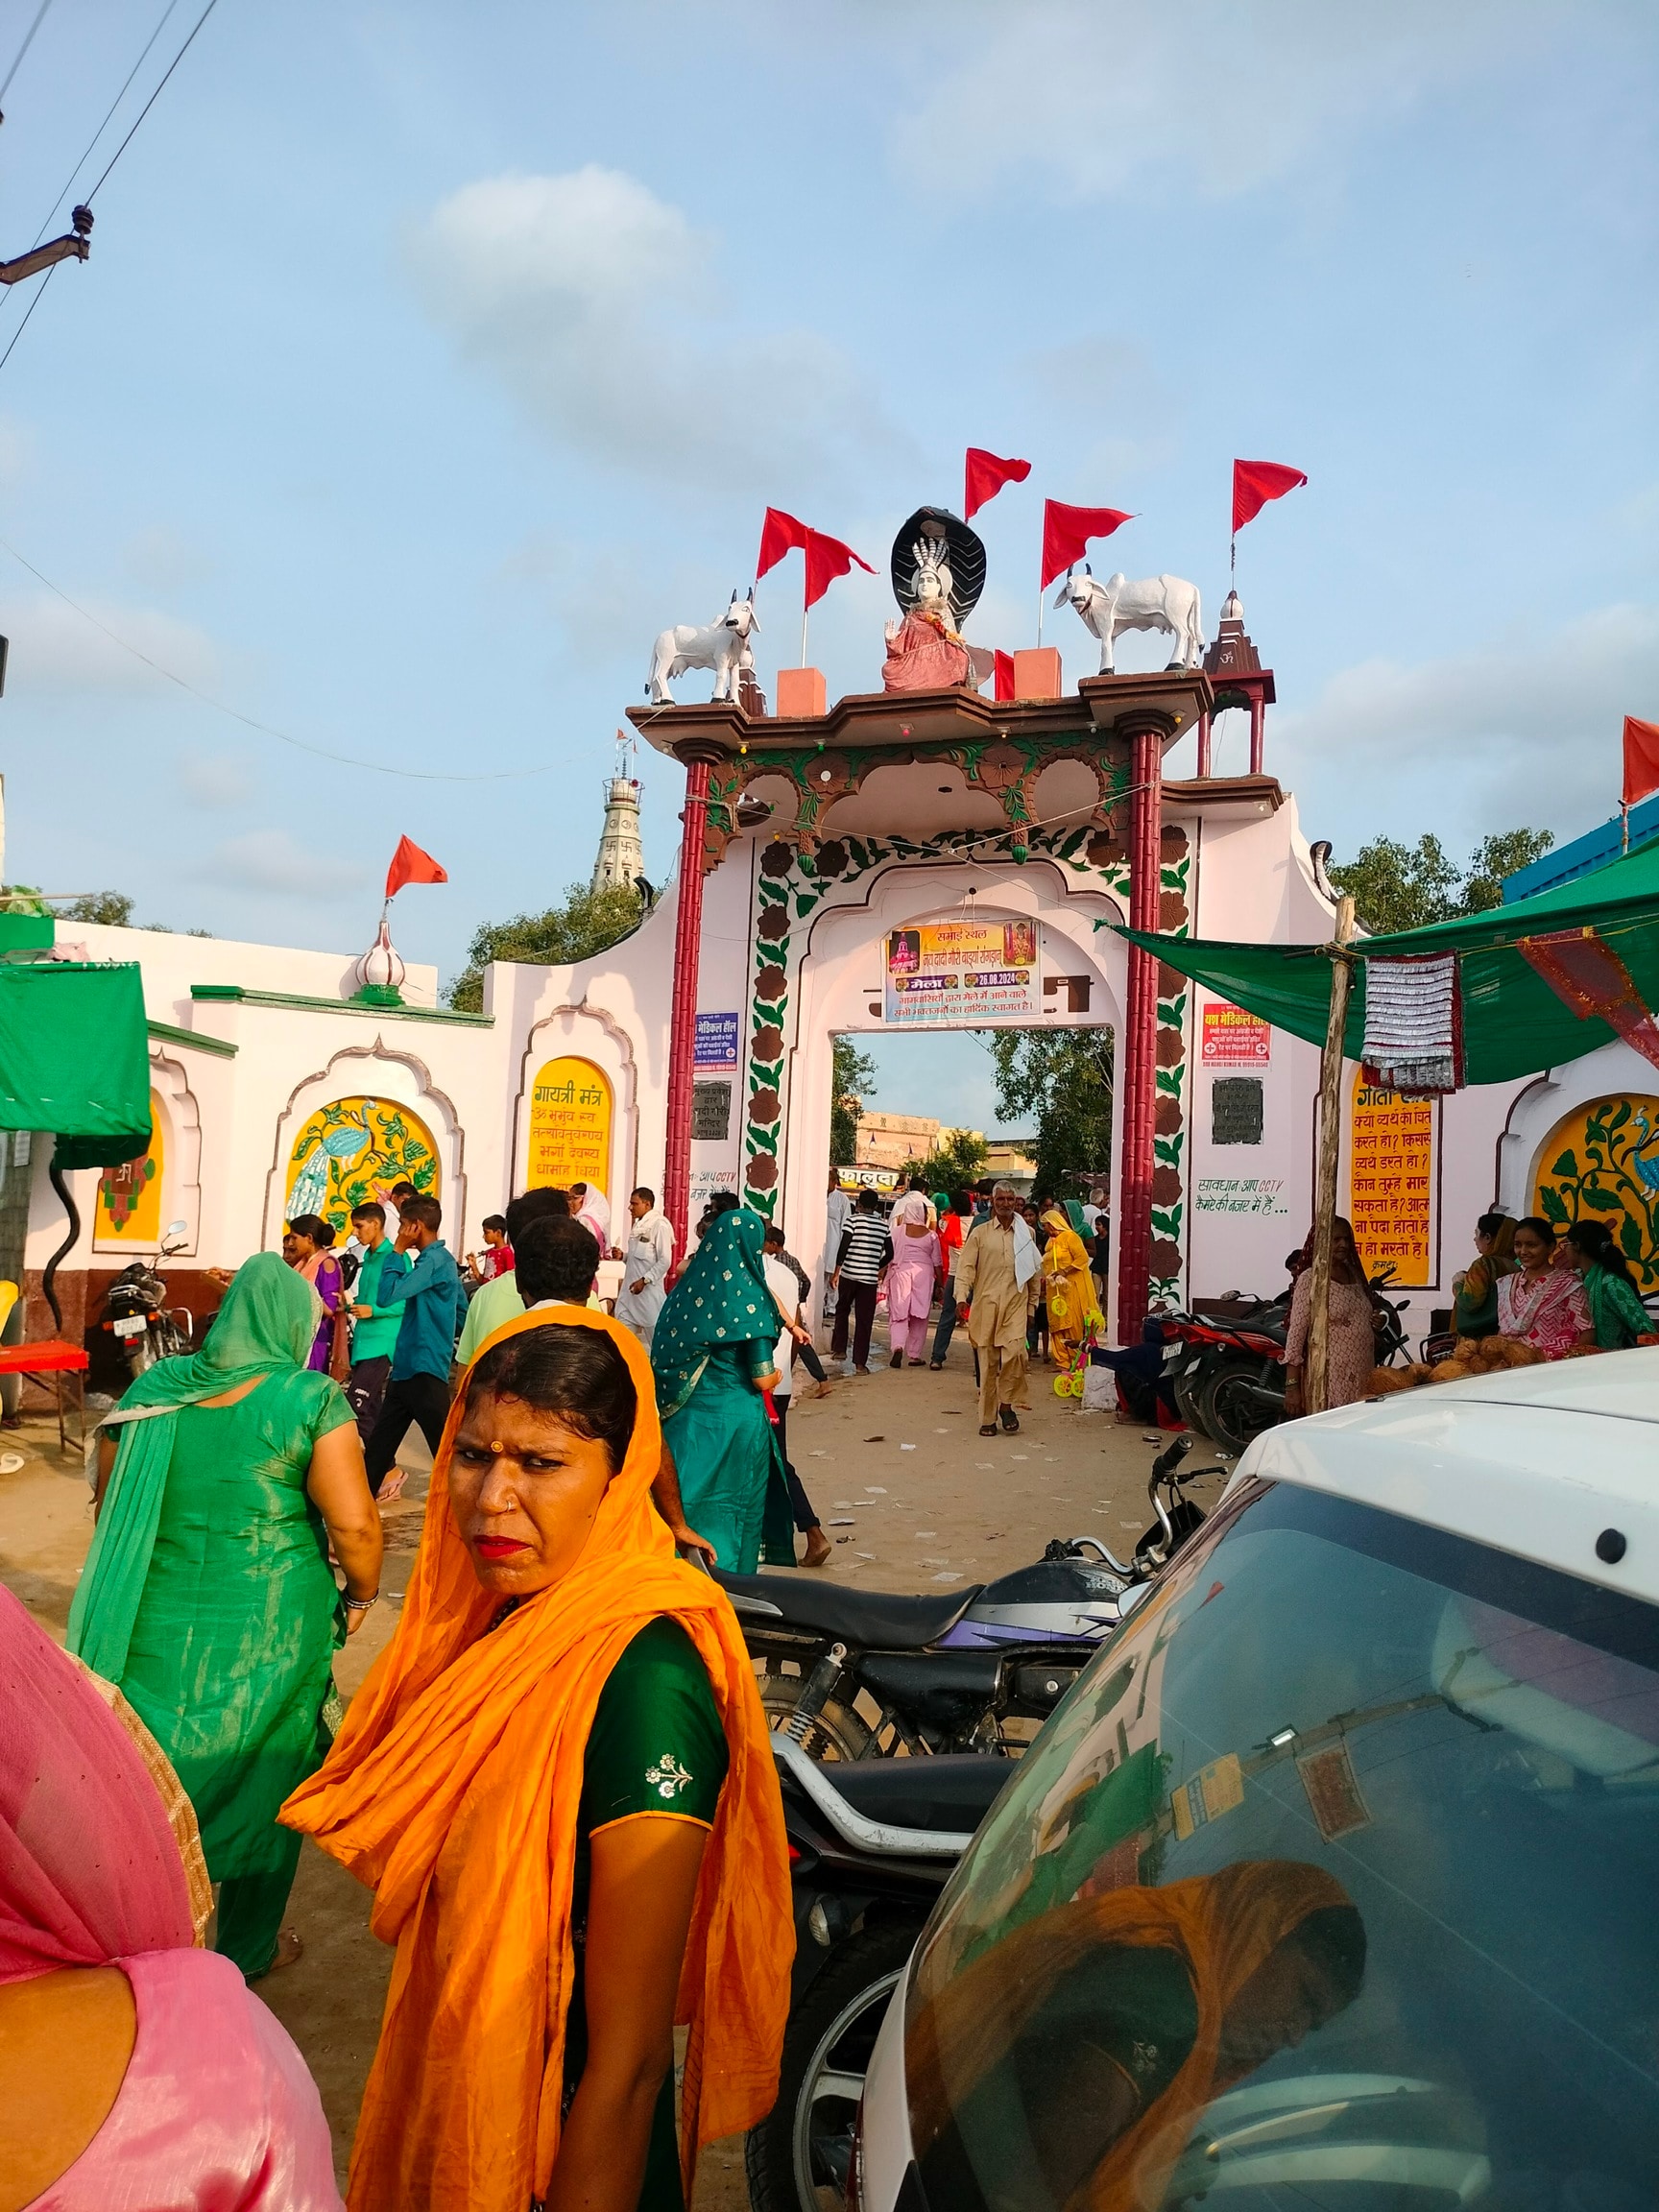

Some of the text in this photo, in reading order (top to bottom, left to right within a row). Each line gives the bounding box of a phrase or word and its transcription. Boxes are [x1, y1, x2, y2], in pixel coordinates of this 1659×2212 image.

[965, 929, 988, 940] स्थल
[934, 948, 947, 967] दादी
[948, 947, 961, 966] गौरी
[910, 978, 943, 989] मेला
[979, 973, 1016, 985] 26.08.2024
[963, 992, 978, 1001] मेले
[979, 990, 989, 1000] में
[991, 990, 1007, 999] आने
[1008, 989, 1026, 998] वाले
[894, 1006, 911, 1017] सभी
[963, 1003, 990, 1014] हार्दिक
[992, 1003, 1021, 1012] स्वागत
[1204, 1014, 1219, 1026] यश
[1220, 1011, 1251, 1026] मेडिकल
[698, 1020, 736, 1034] मेडिकल हॉल
[534, 1079, 604, 1106] गायत्री मंत्र
[1355, 1130, 1378, 1149] करते
[1380, 1150, 1404, 1169] डरते
[715, 1171, 736, 1183] CCTV
[837, 1168, 901, 1190] फालुदा
[1354, 1171, 1376, 1191] कौन
[1406, 1176, 1429, 1190] मार
[1241, 1179, 1260, 1192] आप
[1259, 1179, 1285, 1192] CCTV
[1252, 1194, 1262, 1213] में
[1354, 1198, 1388, 1213] सकता
[1355, 1220, 1367, 1234] ना
